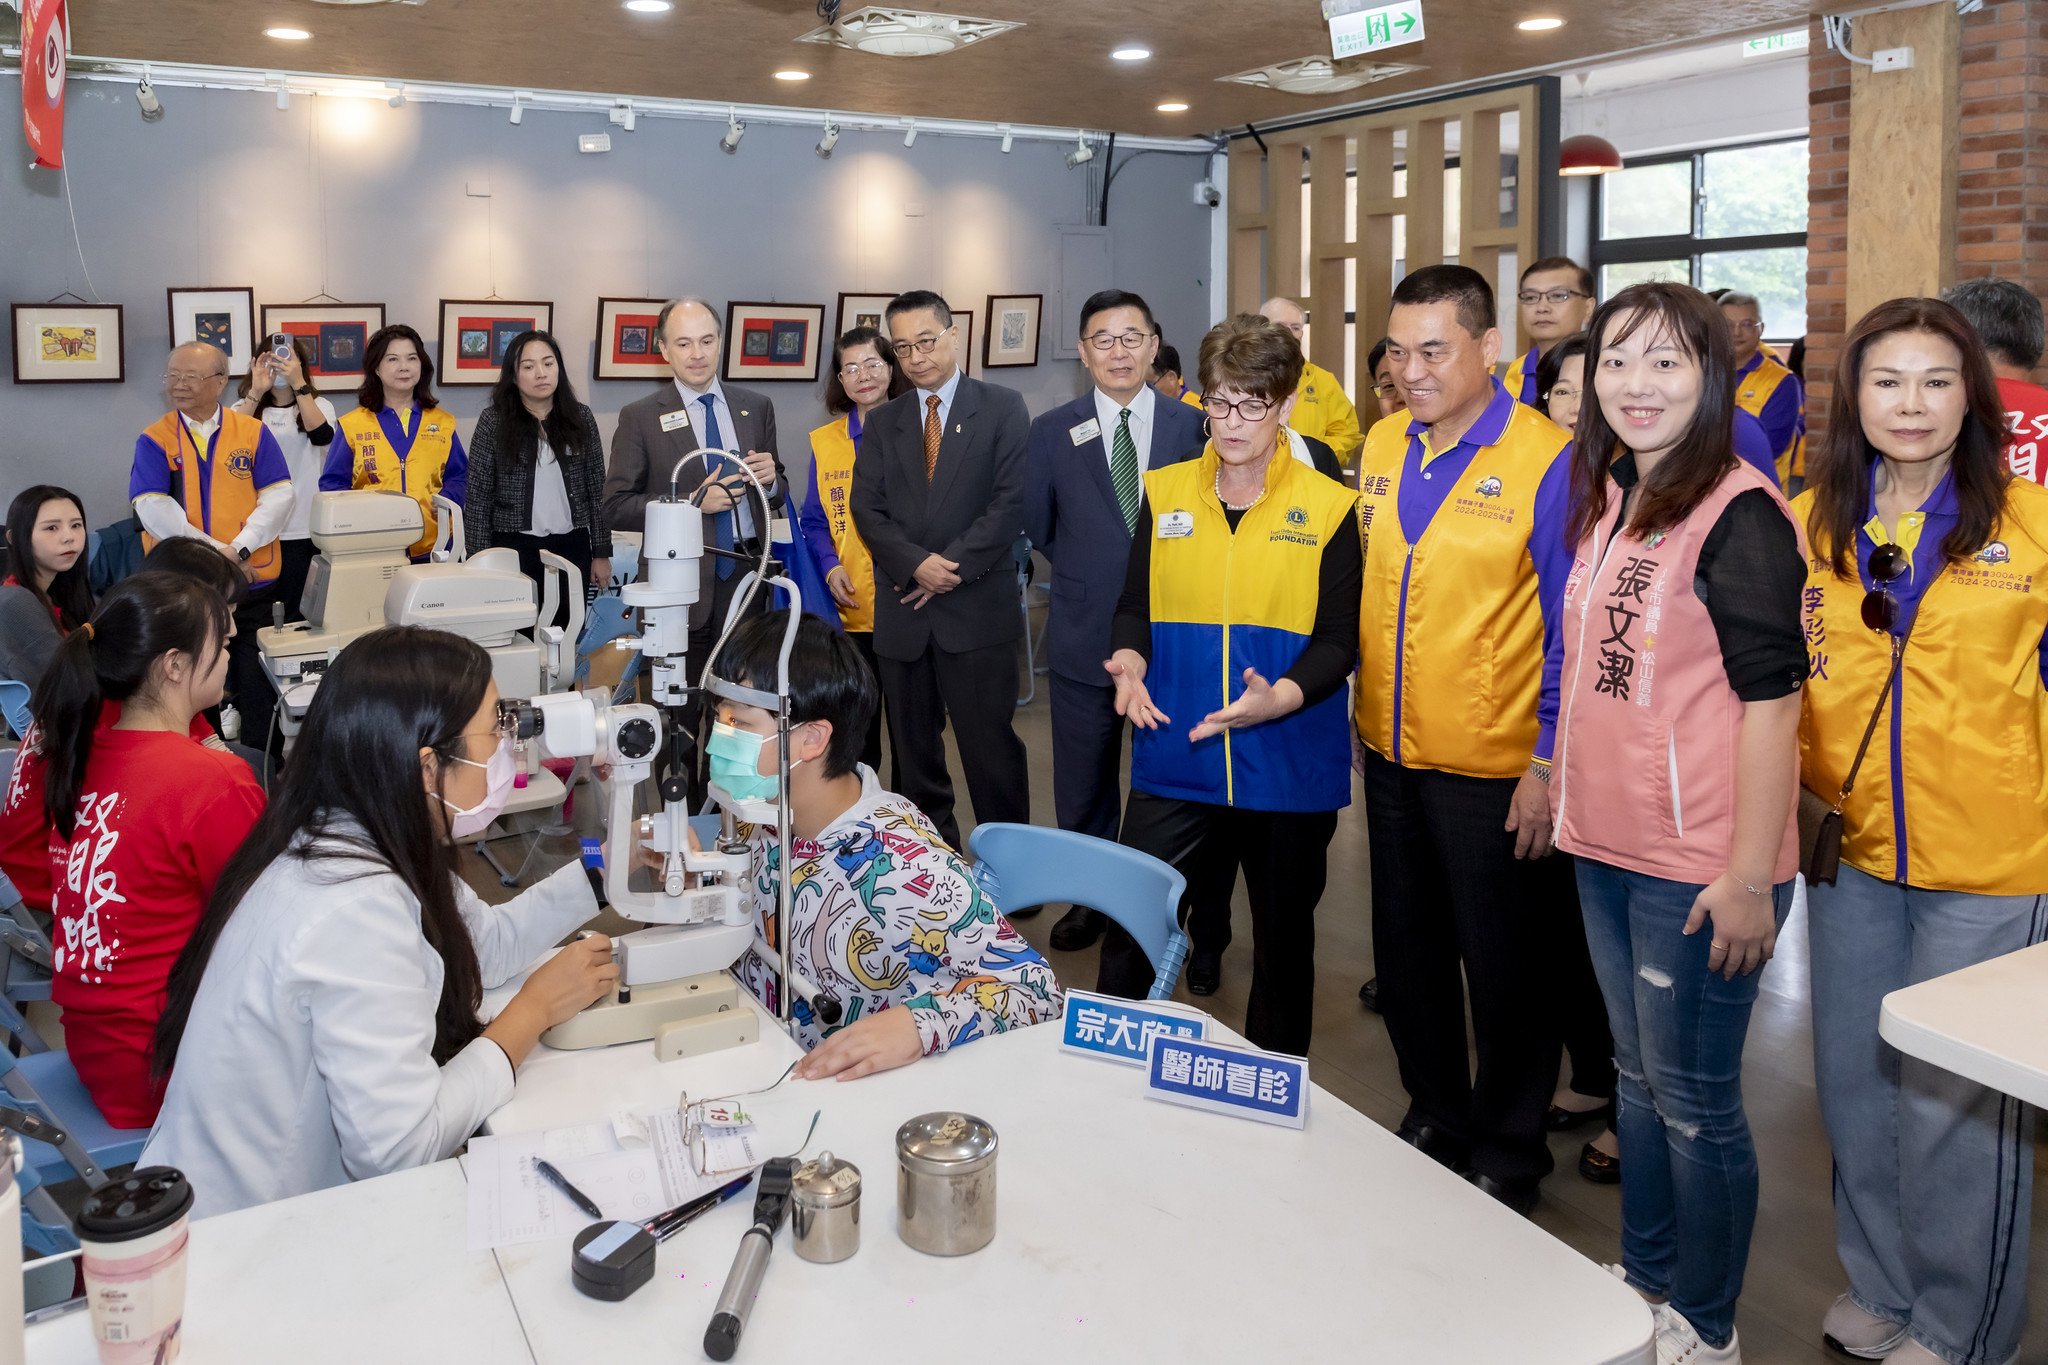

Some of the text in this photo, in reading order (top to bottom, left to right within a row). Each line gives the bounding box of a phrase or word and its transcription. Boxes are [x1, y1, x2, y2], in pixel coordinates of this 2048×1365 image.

[1340, 41, 1363, 52] EXIT
[1364, 474, 1391, 496] 總監
[830, 486, 846, 536] 顏洋洋
[1454, 505, 1514, 524] 2024-2025年度
[1270, 534, 1318, 546] FOUNDATION
[1950, 576, 2031, 593] 2024-2025年度
[1595, 556, 1659, 701] 張文潔
[1636, 650, 1657, 707] 松山信義
[583, 846, 602, 855] ZEISS
[1160, 1047, 1291, 1105] 醫師看診
[710, 1107, 729, 1121] 19
